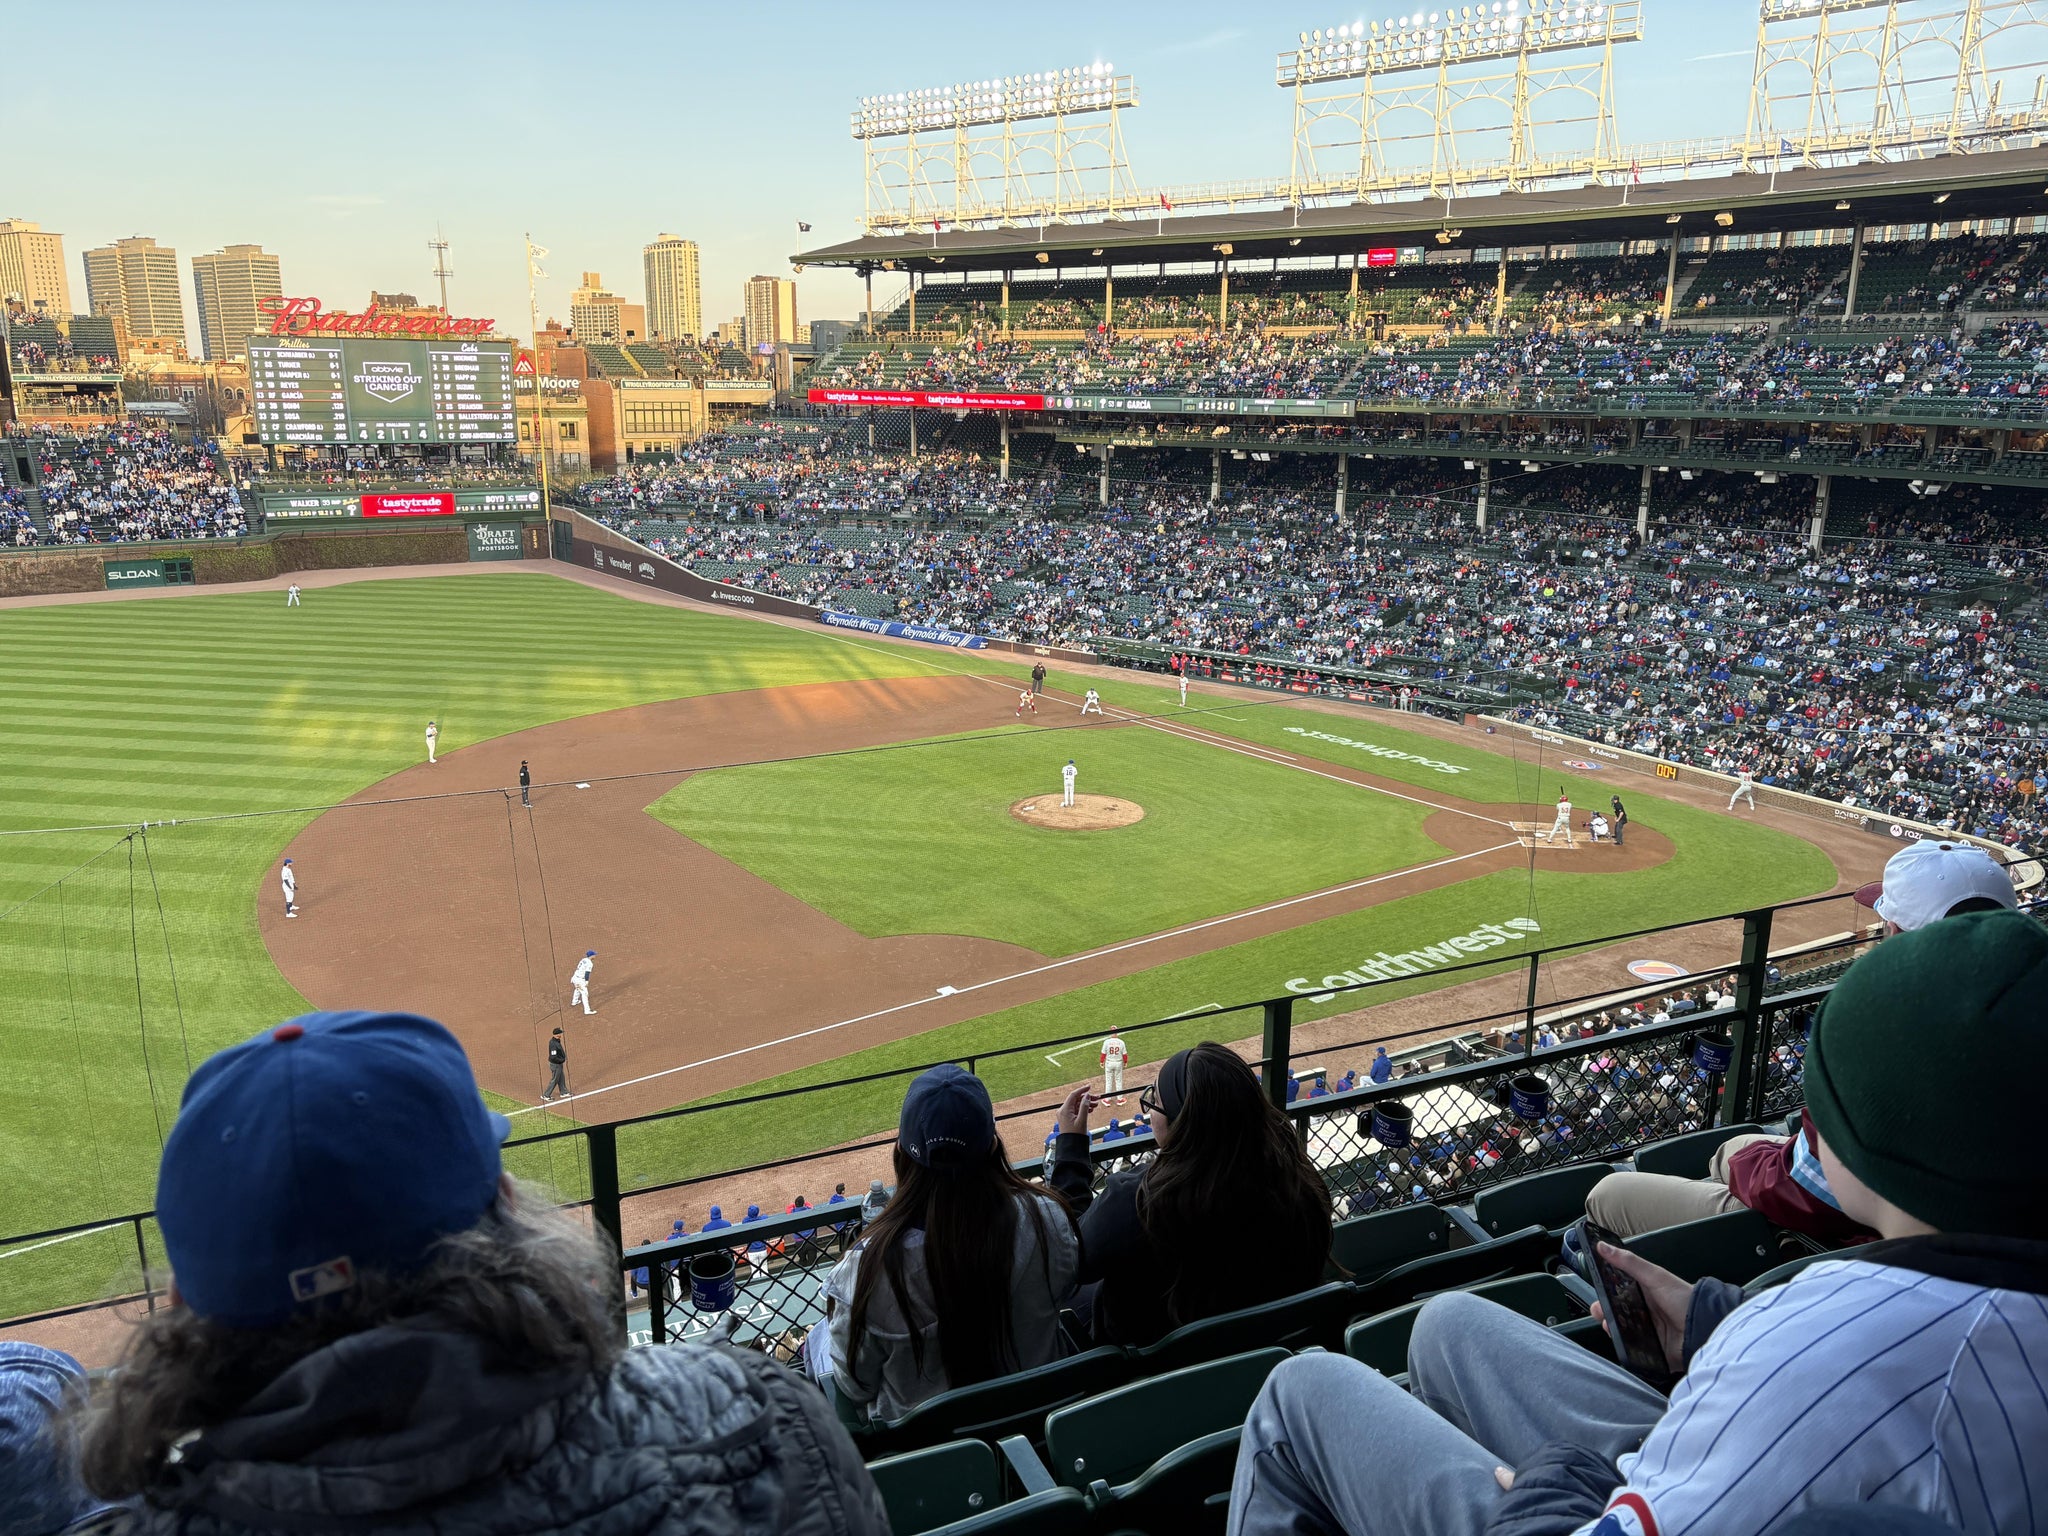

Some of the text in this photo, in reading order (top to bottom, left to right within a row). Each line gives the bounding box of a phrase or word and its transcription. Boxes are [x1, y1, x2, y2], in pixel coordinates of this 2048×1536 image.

[258, 296, 495, 336] Budweiser
[278, 338, 310, 348] Phillies
[461, 343, 478, 352] Cubs
[353, 375, 401, 383] STRIKING
[538, 376, 579, 388] Moore
[369, 383, 409, 391] CANCER
[826, 393, 858, 402] tastytrade
[928, 395, 964, 405] tastytrade
[1127, 400, 1151, 410] GARCÍA
[1205, 401, 1210, 410] 2
[1217, 401, 1222, 410] 2
[1230, 401, 1235, 410] 0
[360, 430, 427, 439] 4 2 1 4
[290, 499, 320, 507] WALKER
[383, 497, 442, 509] tastytrade
[476, 530, 515, 540] DRAFT
[482, 537, 515, 545] KINGS
[720, 591, 741, 601] Invesco
[742, 595, 754, 604] QQQ
[826, 614, 879, 634] Reynolds Wrap
[901, 626, 960, 646] Reynolds Wrap
[1301, 730, 1471, 774] Southwest
[1595, 748, 1619, 760] Advocate
[1656, 764, 1676, 780] 004
[1834, 809, 1859, 820] DAISO
[1904, 829, 1923, 839] razr
[1284, 922, 1526, 1004] Southwest
[1110, 1047, 1120, 1055] 62
[628, 1299, 774, 1348] INTRST
